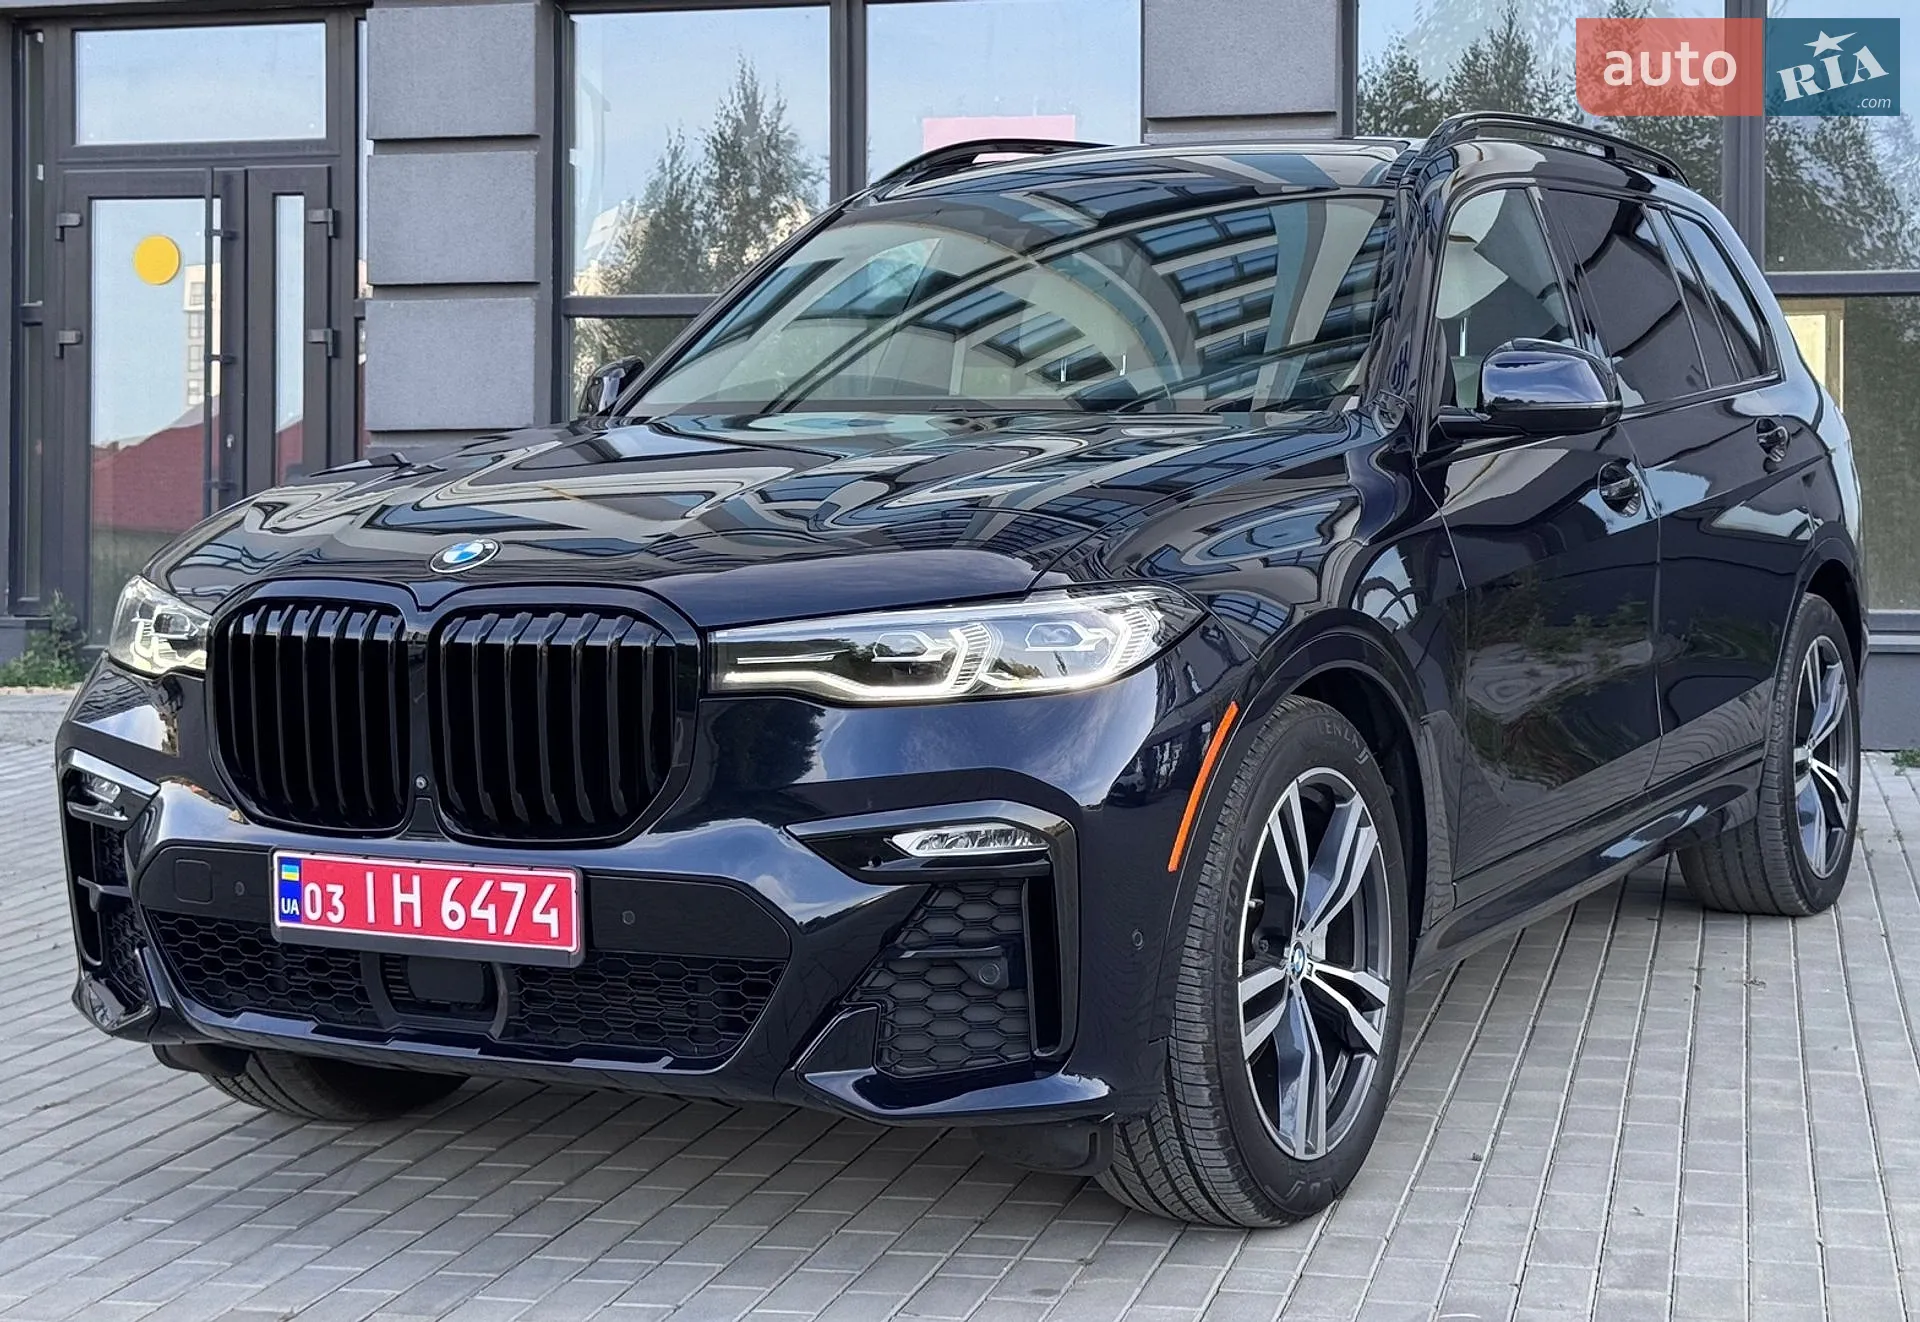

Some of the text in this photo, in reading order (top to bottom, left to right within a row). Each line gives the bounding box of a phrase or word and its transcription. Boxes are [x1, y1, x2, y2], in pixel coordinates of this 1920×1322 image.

[281, 898, 300, 916] UA
[304, 882, 345, 924] 03
[441, 877, 560, 939] 6474
[1220, 836, 1249, 1068] RIDGESTONE
